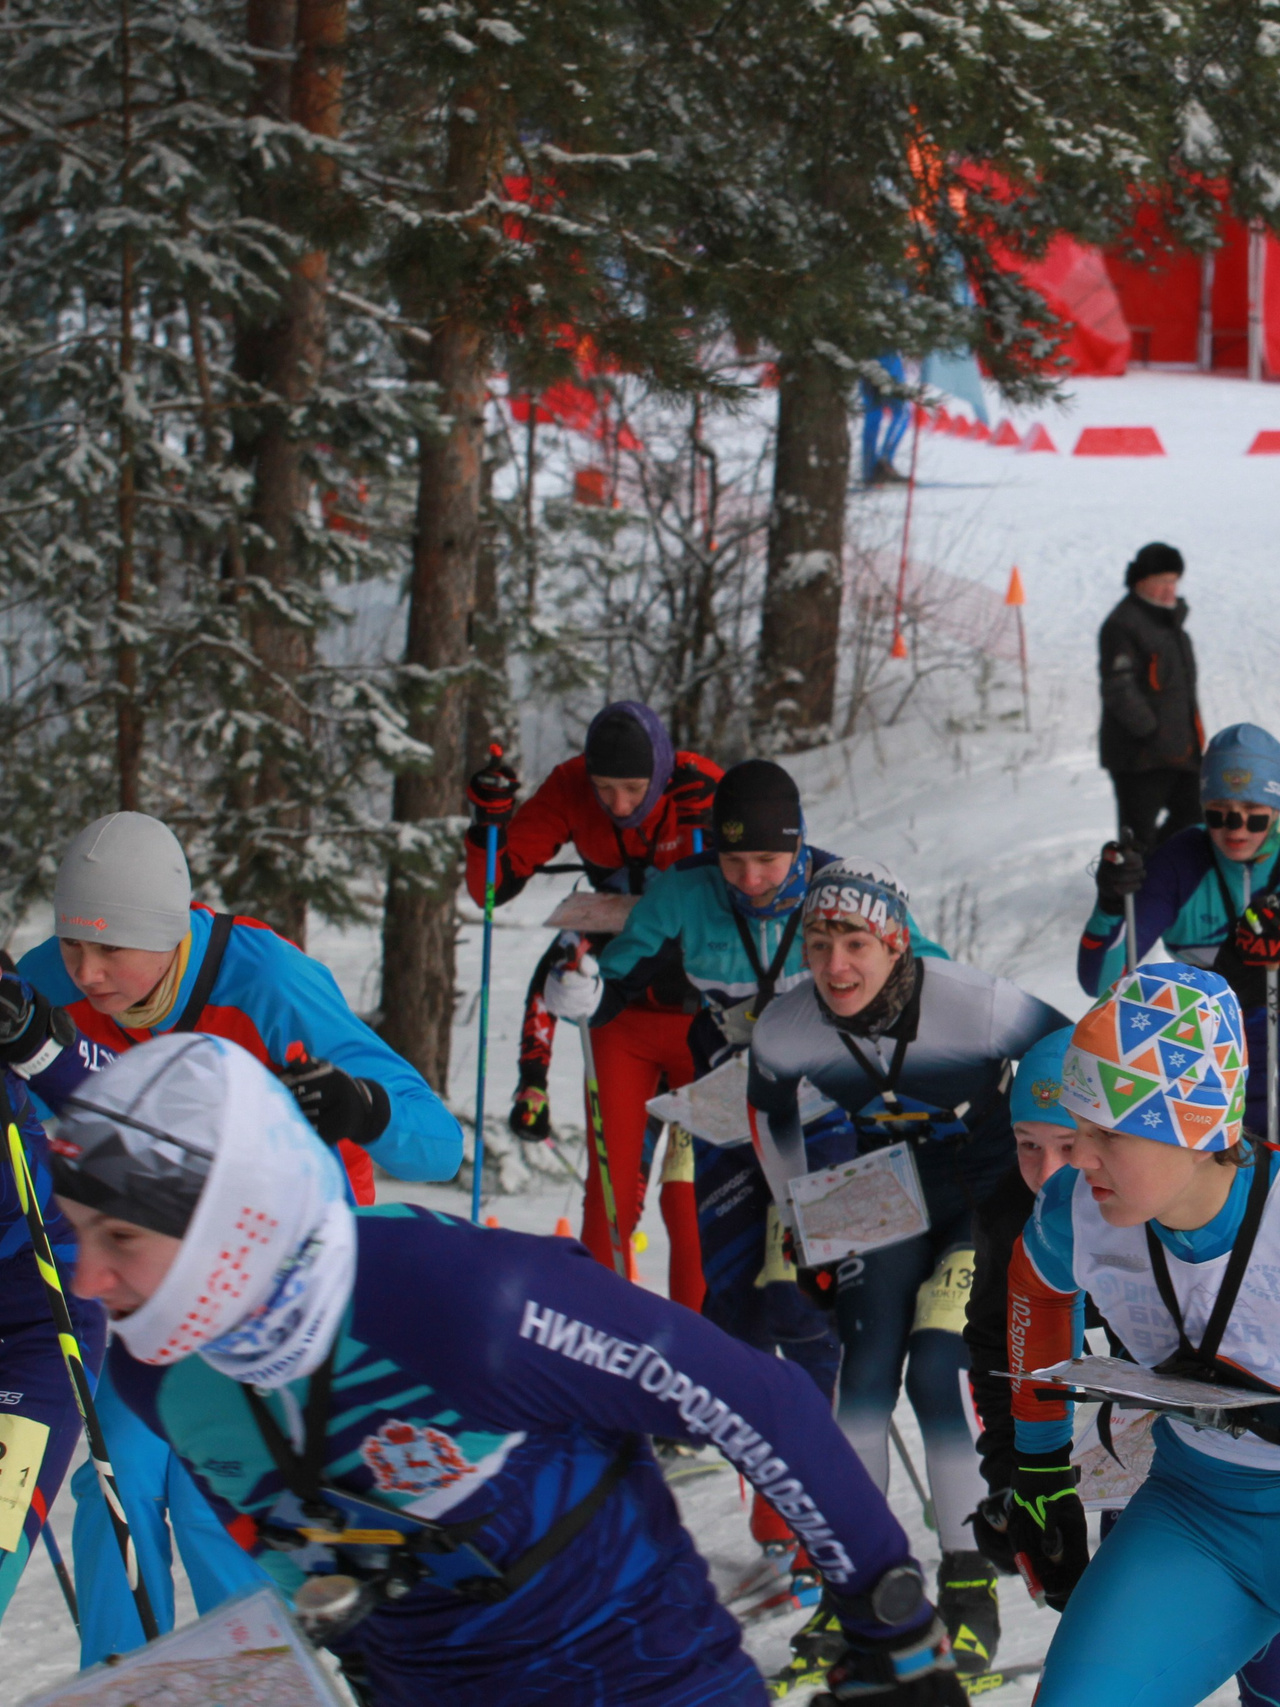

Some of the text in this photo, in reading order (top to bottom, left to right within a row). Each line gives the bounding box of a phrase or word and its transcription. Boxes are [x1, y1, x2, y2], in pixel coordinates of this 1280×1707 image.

[1183, 1111, 1213, 1126] OMR
[519, 1299, 789, 1487] НИЖЕГОРОДСКАЯ
[946, 1578, 988, 1589] FISCHER
